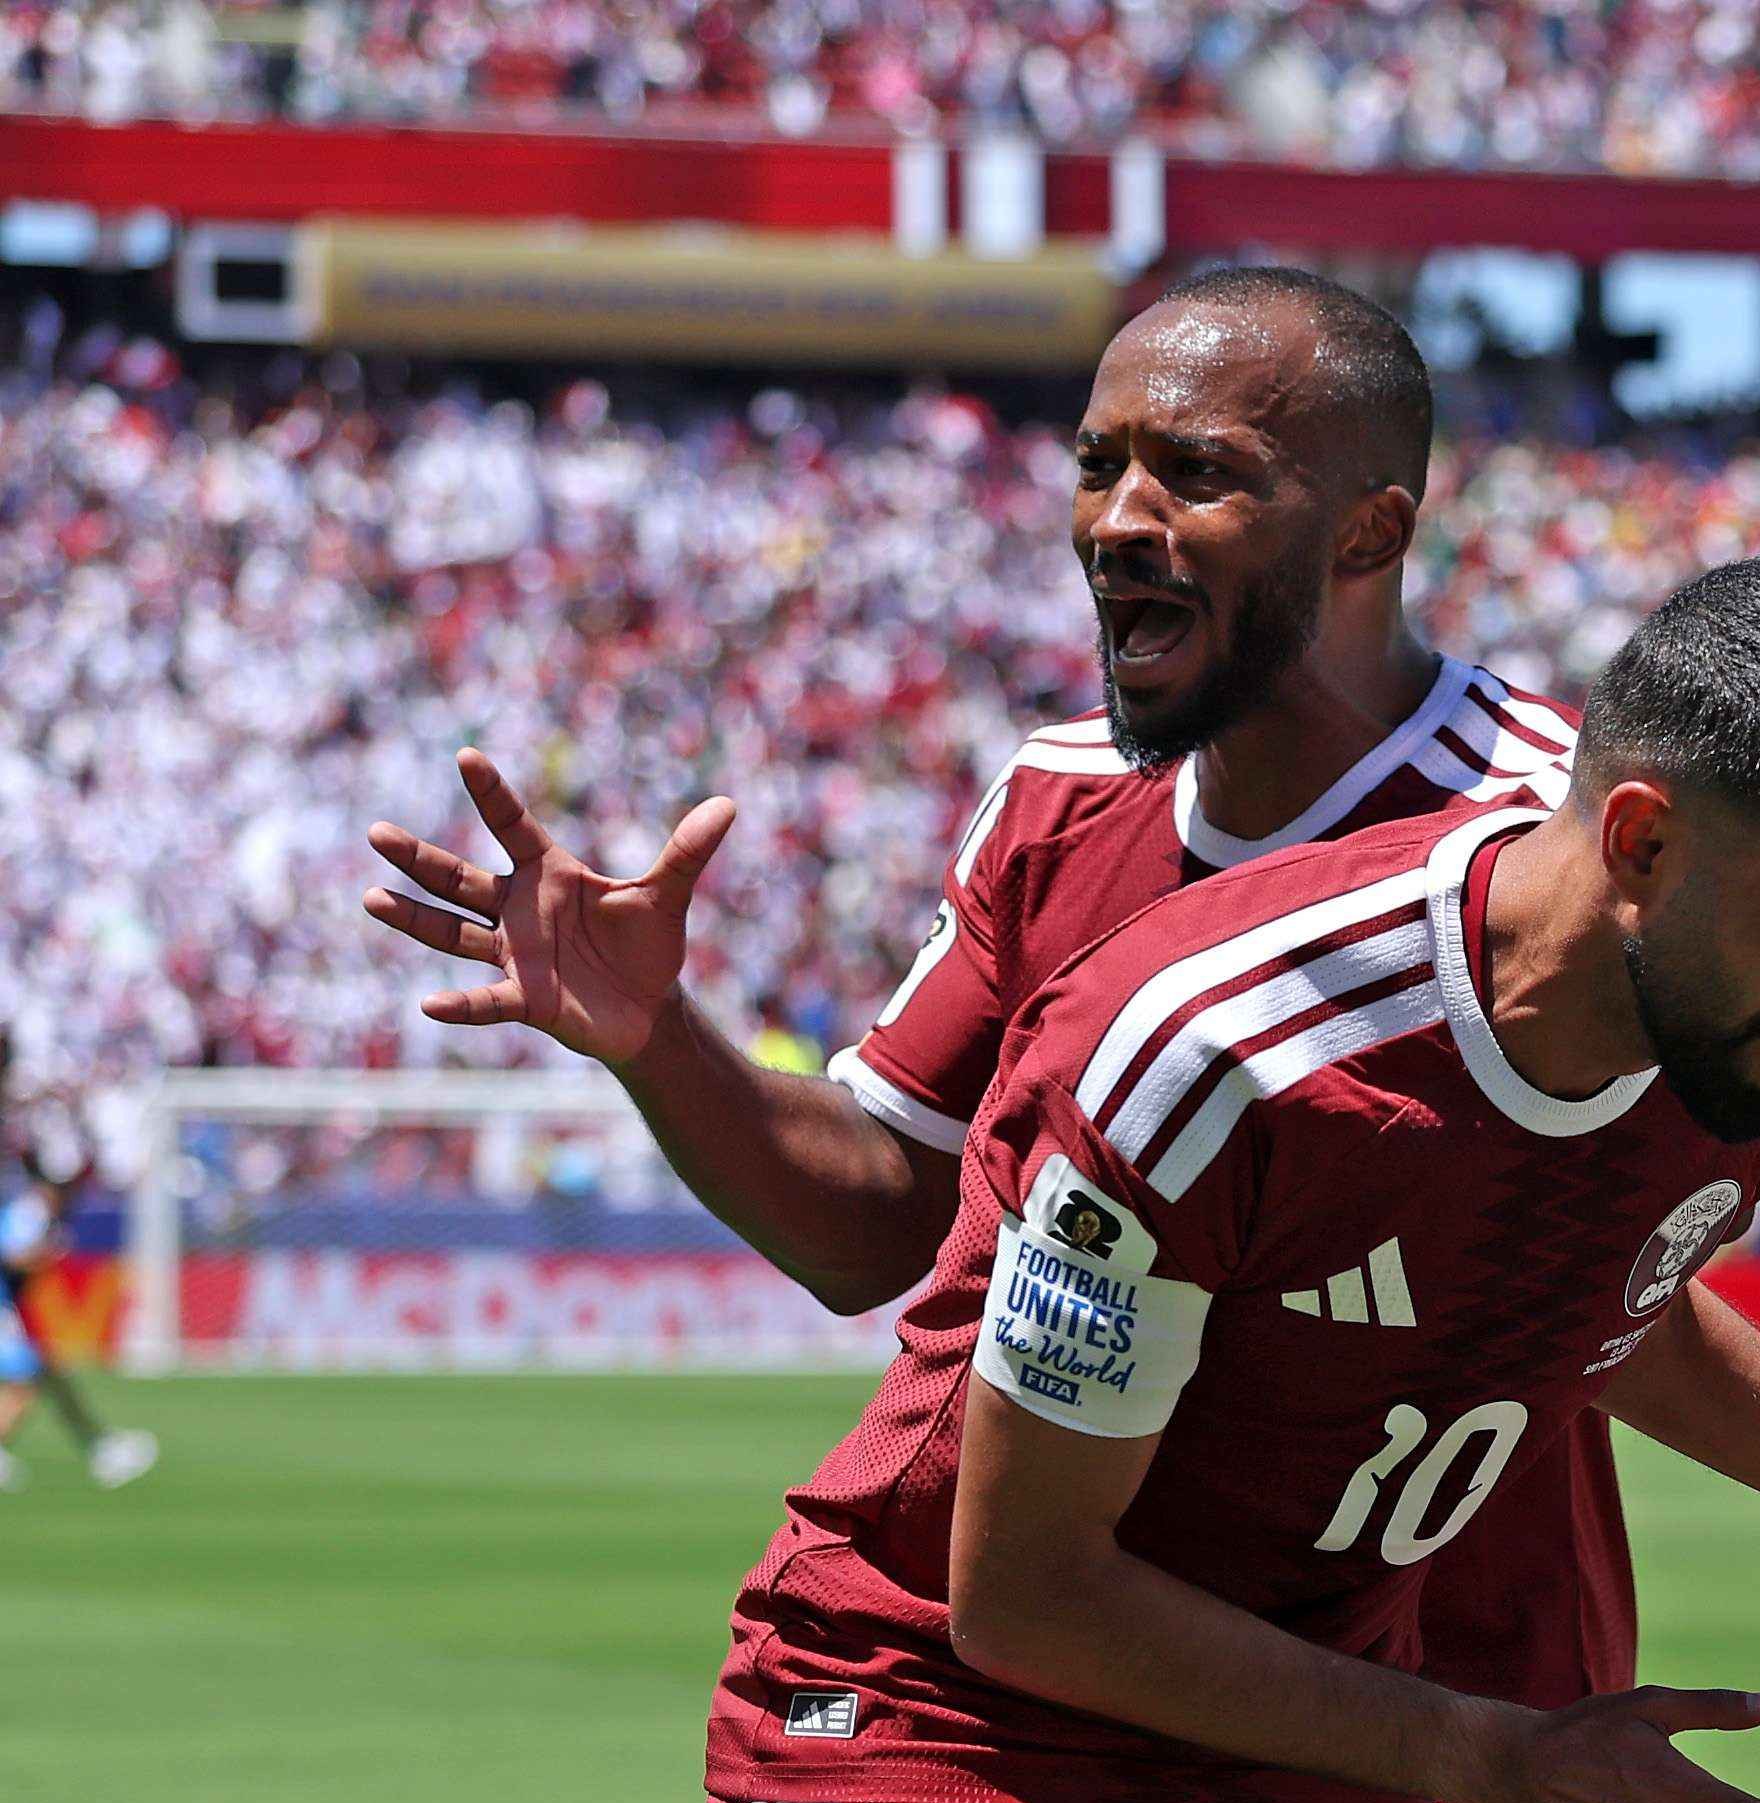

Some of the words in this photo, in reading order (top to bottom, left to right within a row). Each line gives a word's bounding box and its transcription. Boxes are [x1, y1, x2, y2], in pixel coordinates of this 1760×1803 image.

[1006, 1271, 1135, 1354] UNITES
[1016, 1240, 1139, 1314] FOOTBALL
[994, 1314, 1033, 1355] the
[1036, 1333, 1137, 1394] World
[1023, 1367, 1076, 1400] FIFA
[1313, 1400, 1529, 1566] 10
